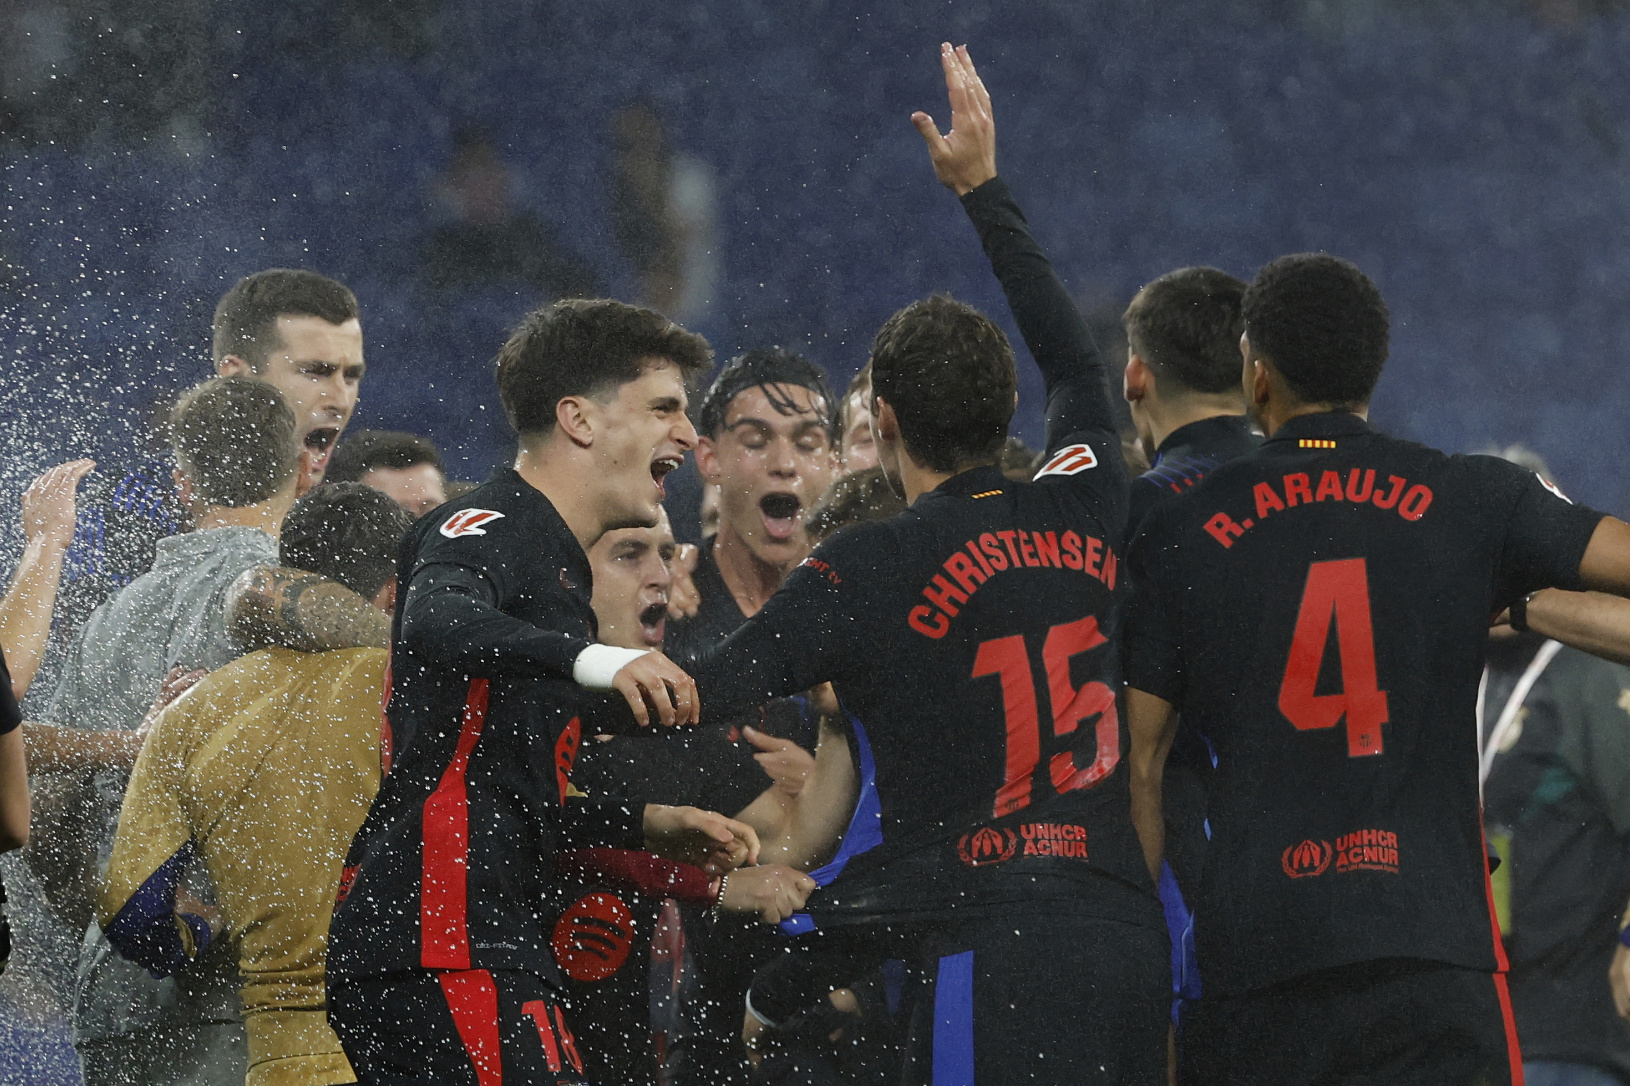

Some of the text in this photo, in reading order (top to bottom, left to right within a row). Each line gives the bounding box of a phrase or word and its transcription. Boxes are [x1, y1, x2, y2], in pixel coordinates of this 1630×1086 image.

[1203, 468, 1434, 549] R. ARAUJO
[908, 529, 1117, 639] CHRISTENSEN
[1278, 558, 1389, 757] 4
[972, 615, 1120, 819] 15
[1020, 823, 1088, 840] UNHCR
[1022, 839, 1088, 858] ACNUR
[1336, 829, 1399, 851] UNHCR
[1336, 846, 1399, 867] ACNUR
